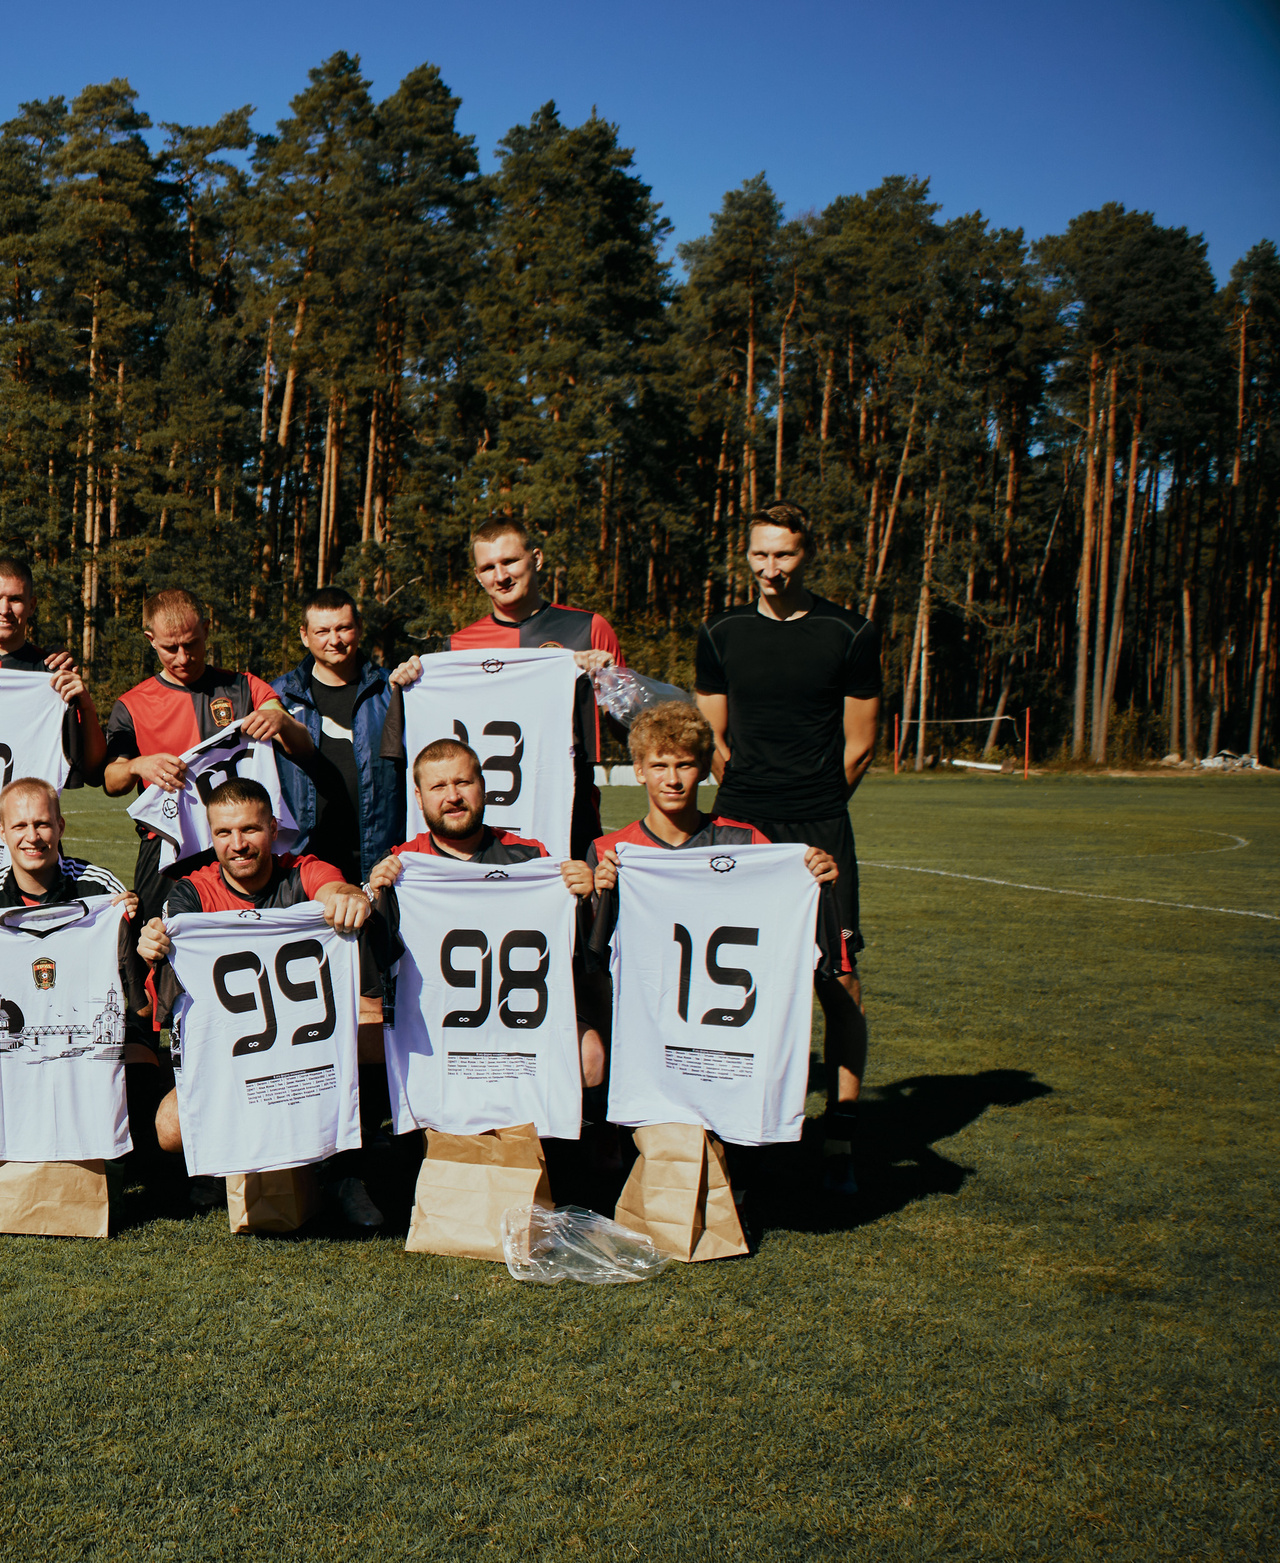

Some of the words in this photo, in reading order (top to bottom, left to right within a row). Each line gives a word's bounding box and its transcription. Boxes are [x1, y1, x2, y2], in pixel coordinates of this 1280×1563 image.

[453, 719, 524, 806] 3
[213, 939, 336, 1057] 99
[440, 929, 550, 1029] 98
[673, 923, 759, 1027] 15
